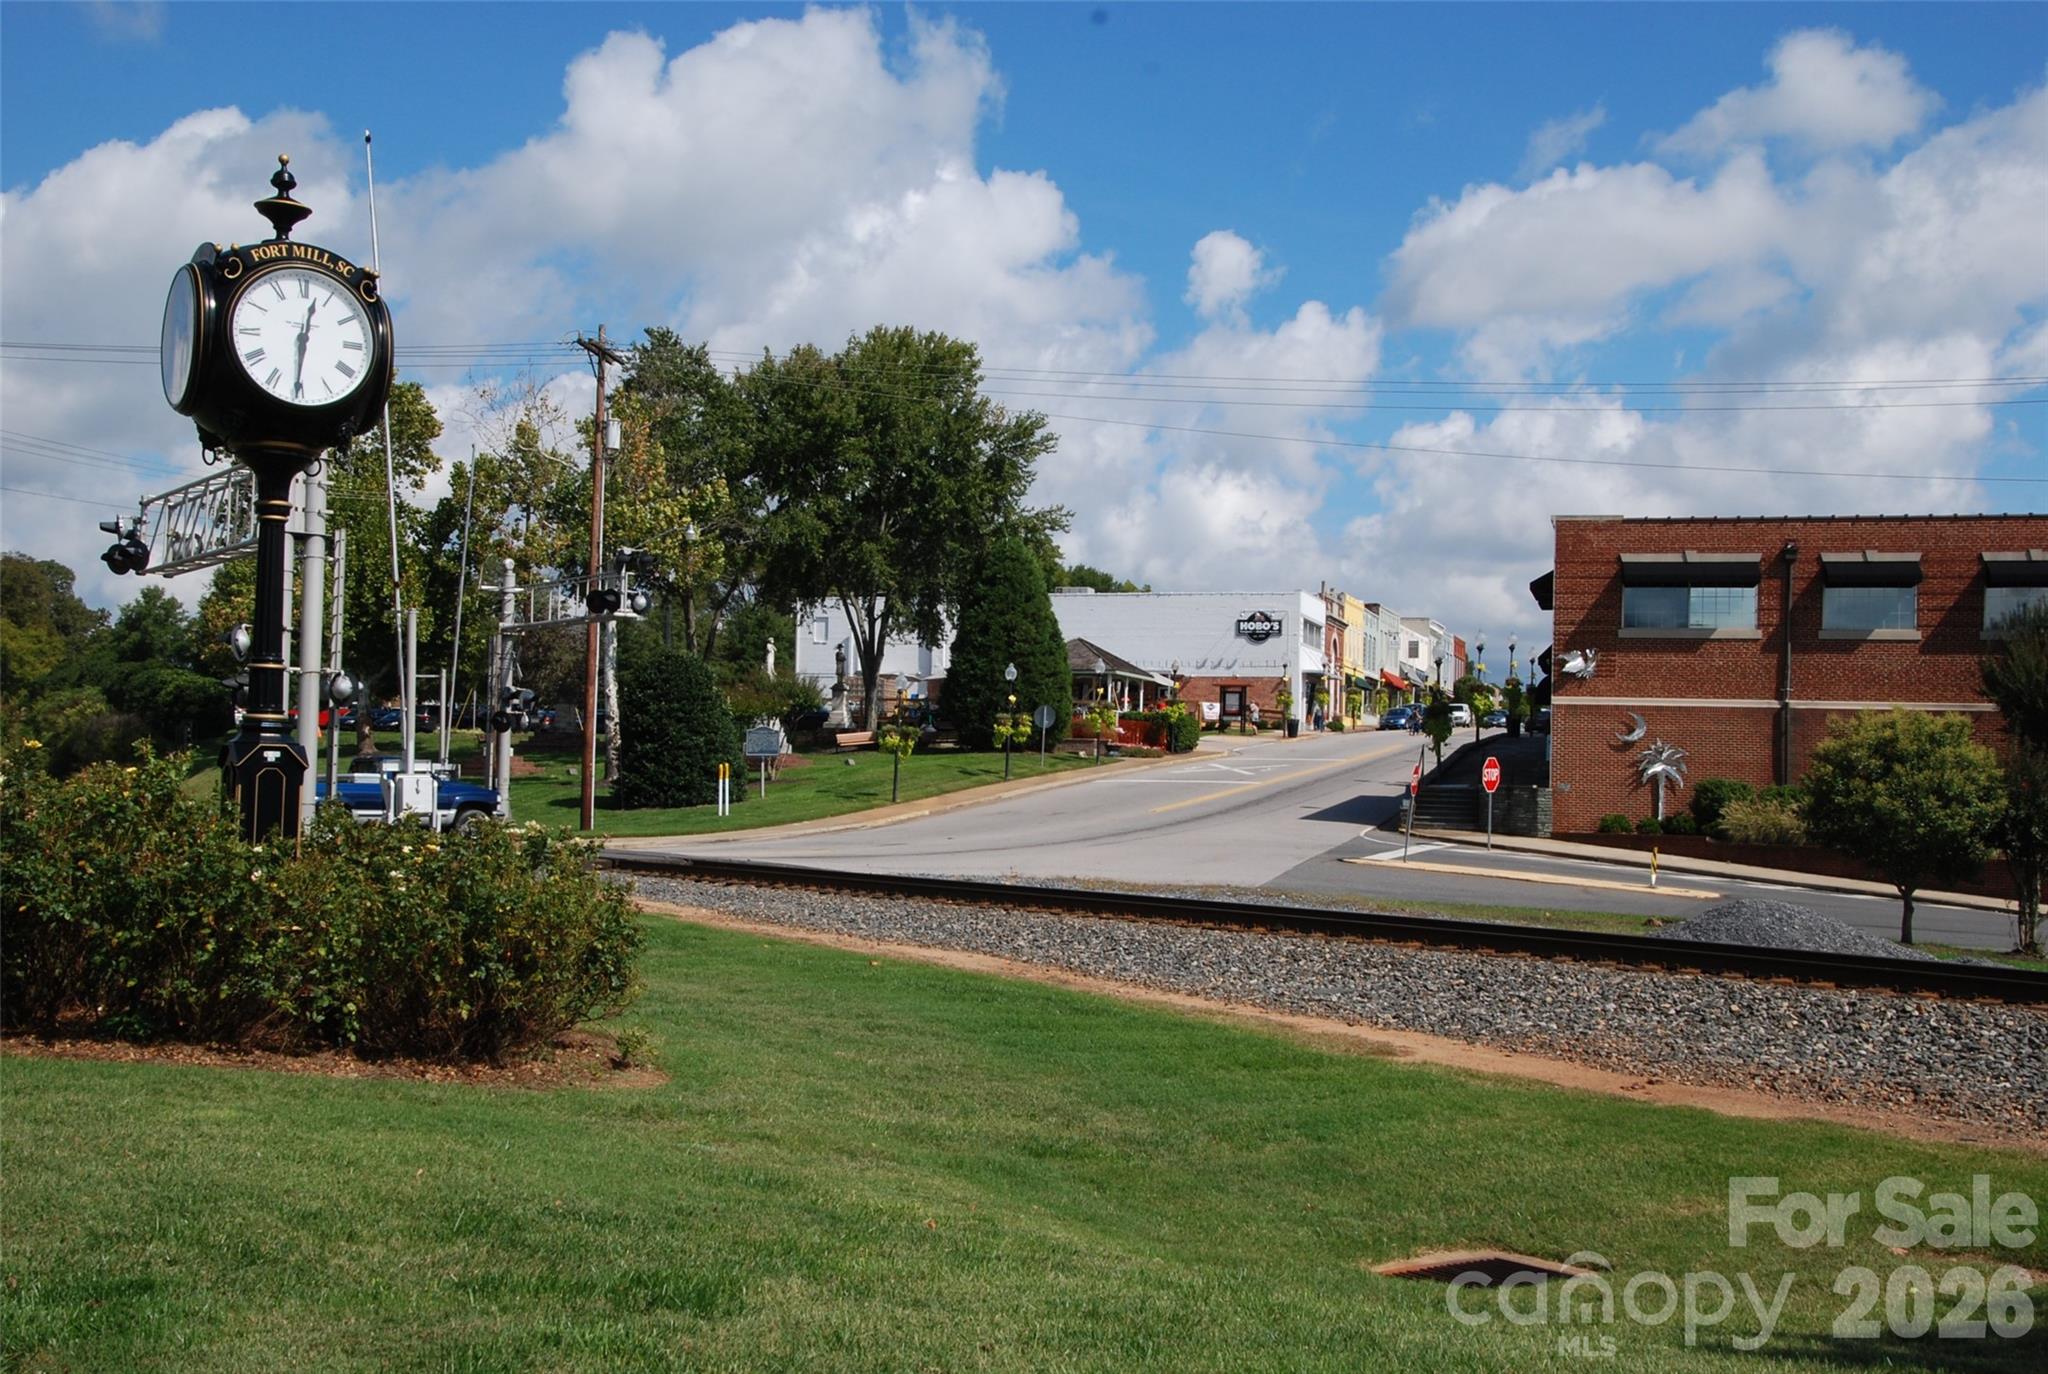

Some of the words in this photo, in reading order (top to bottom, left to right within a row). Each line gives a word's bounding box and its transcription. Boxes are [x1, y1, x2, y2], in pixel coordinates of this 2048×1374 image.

[250, 244, 289, 262] FORT
[292, 245, 334, 269] MILL,
[336, 261, 355, 278] SC
[1240, 621, 1280, 630] HOBO'S
[1483, 768, 1499, 782] STOP
